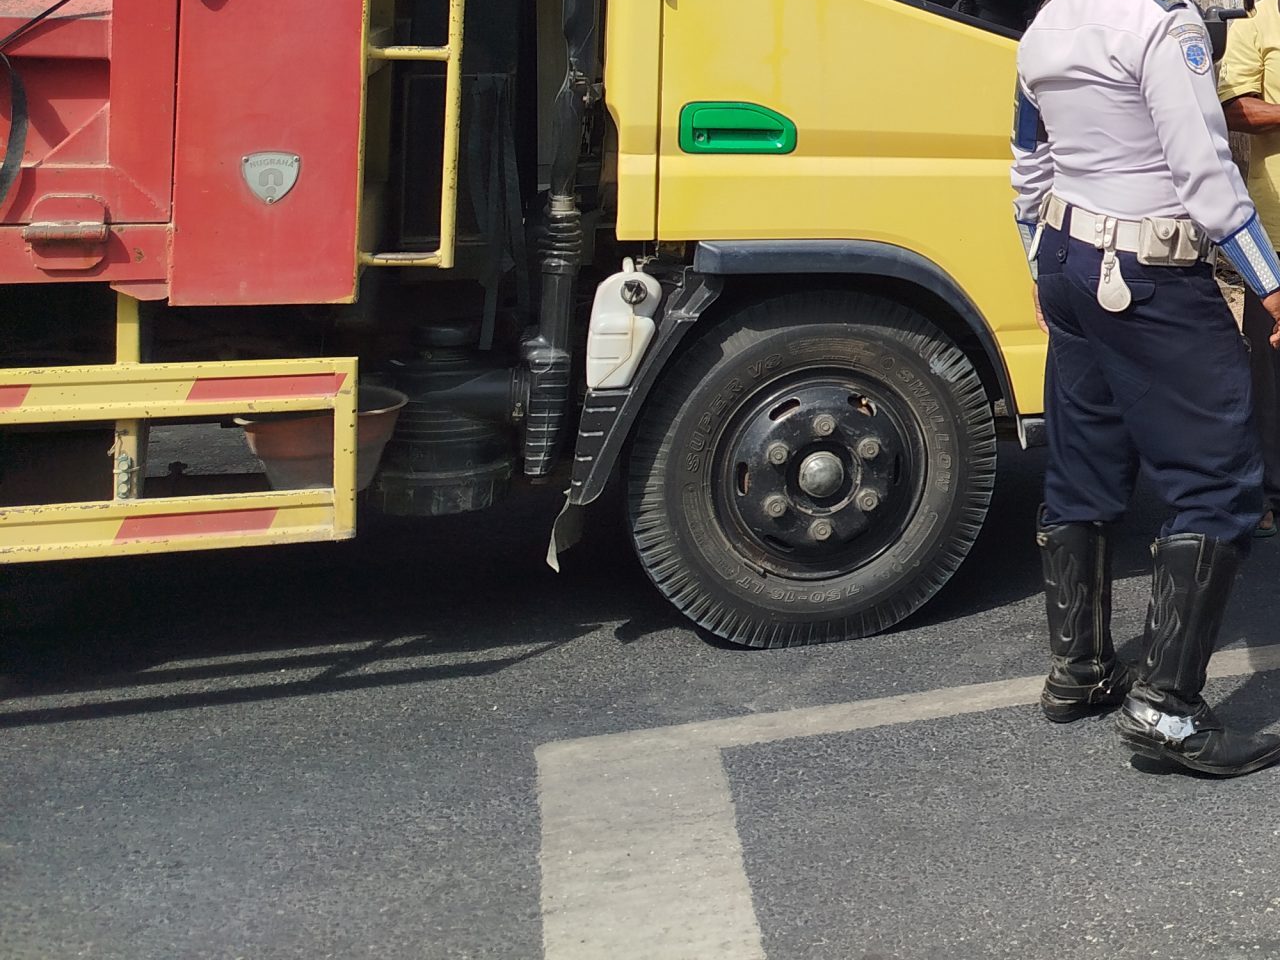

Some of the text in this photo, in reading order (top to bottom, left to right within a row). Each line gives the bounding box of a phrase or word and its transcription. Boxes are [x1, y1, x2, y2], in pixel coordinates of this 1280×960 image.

[249, 158, 294, 168] NUGRAHA
[686, 377, 743, 473] SUPER
[896, 368, 951, 492] SWALLOW
